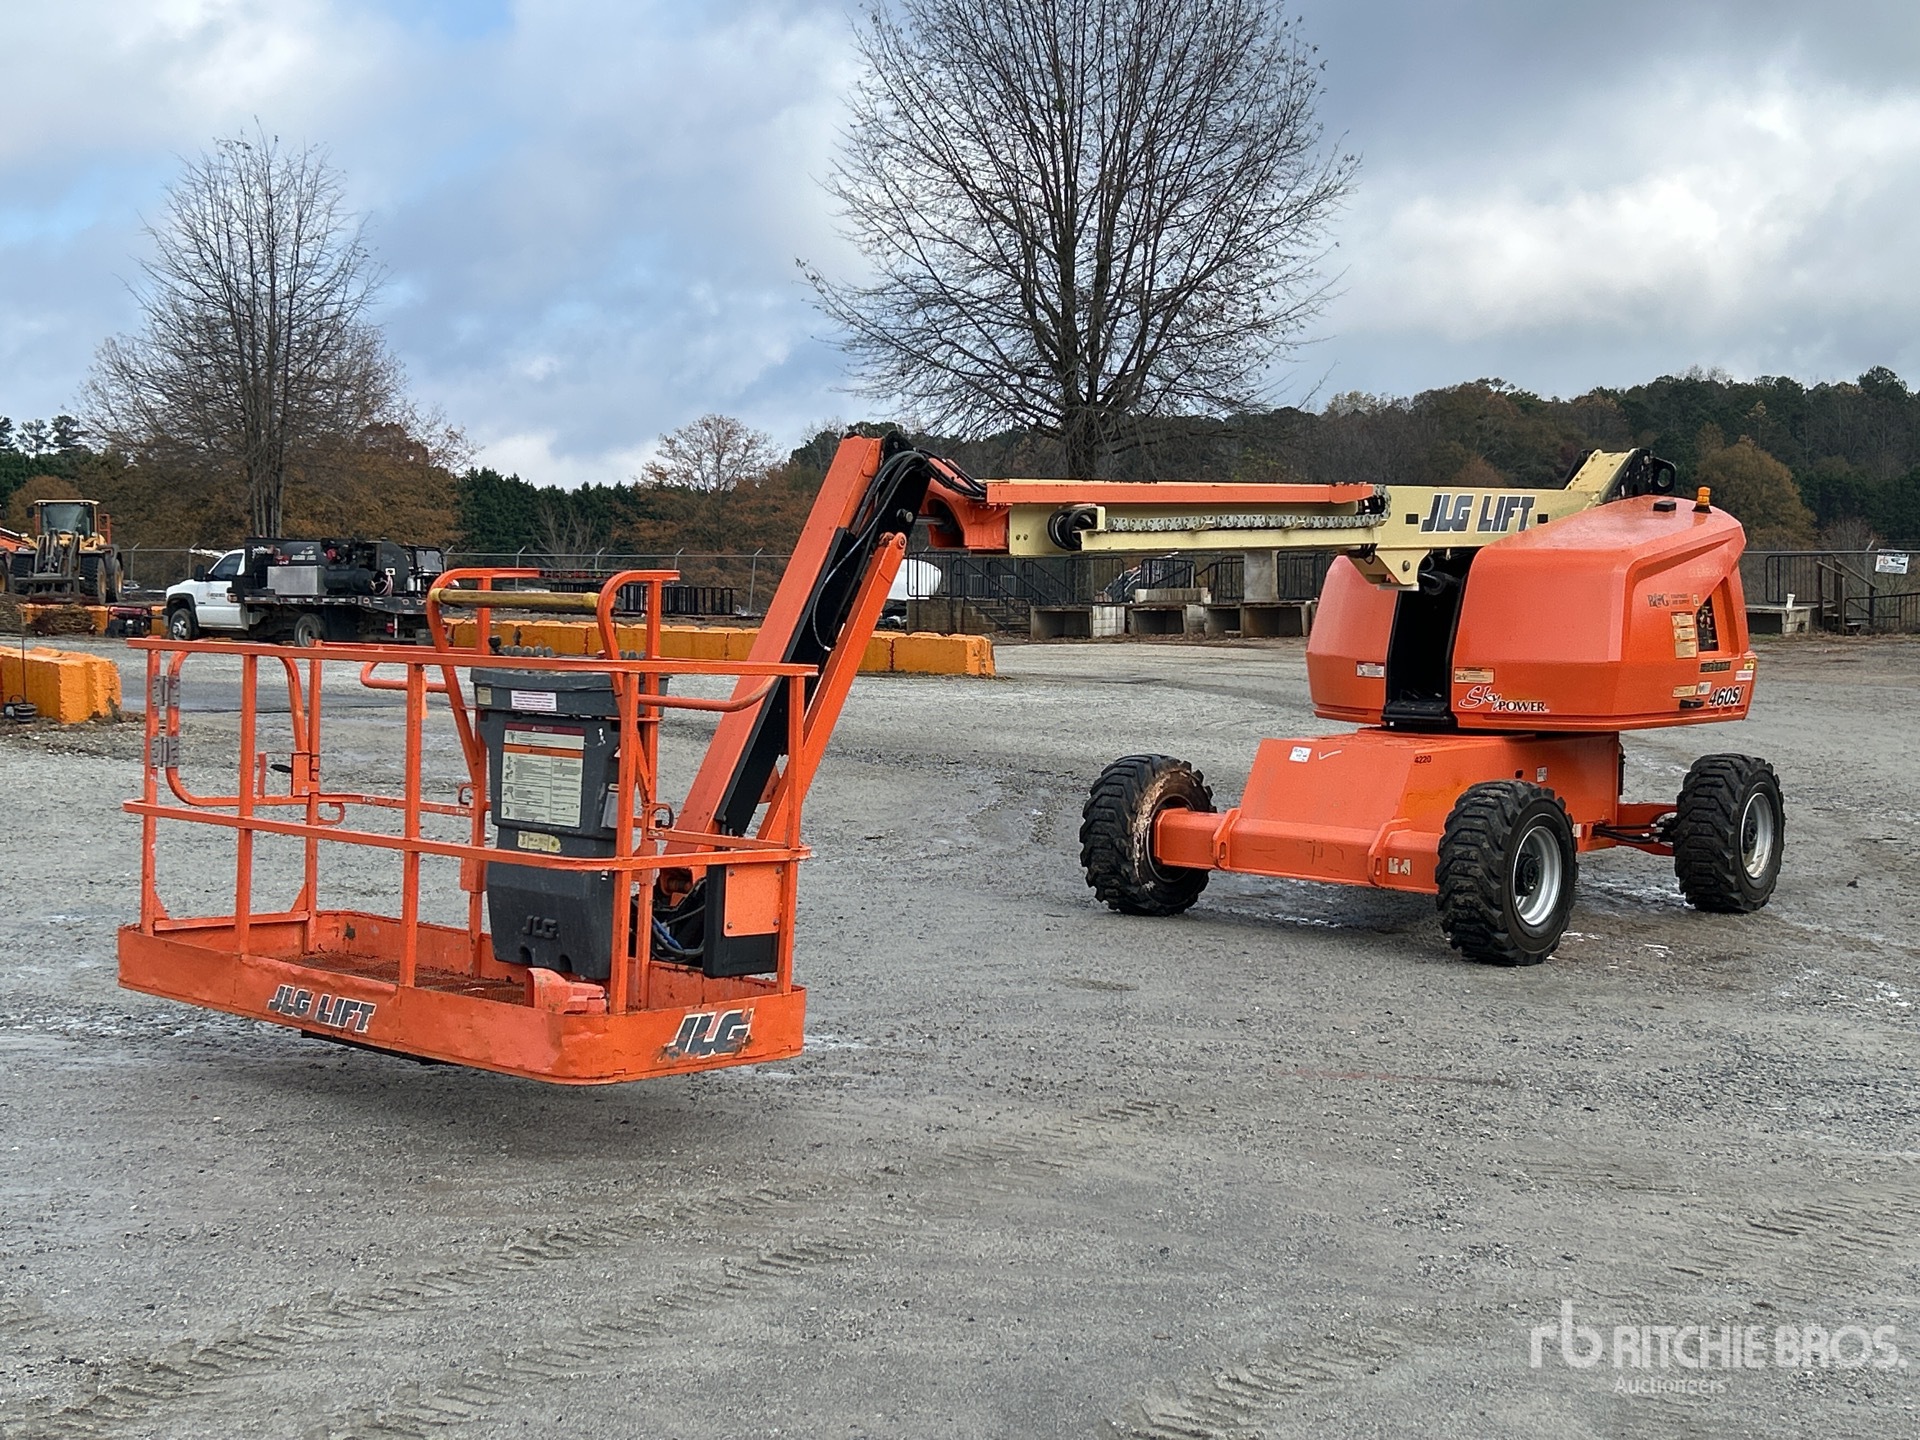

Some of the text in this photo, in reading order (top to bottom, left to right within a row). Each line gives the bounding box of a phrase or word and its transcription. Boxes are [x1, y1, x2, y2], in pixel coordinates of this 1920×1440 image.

[1420, 493, 1536, 533] JLG LIFT
[521, 915, 558, 939] JLG
[267, 984, 377, 1033] JLG LIFT
[657, 1007, 755, 1062] JLG
